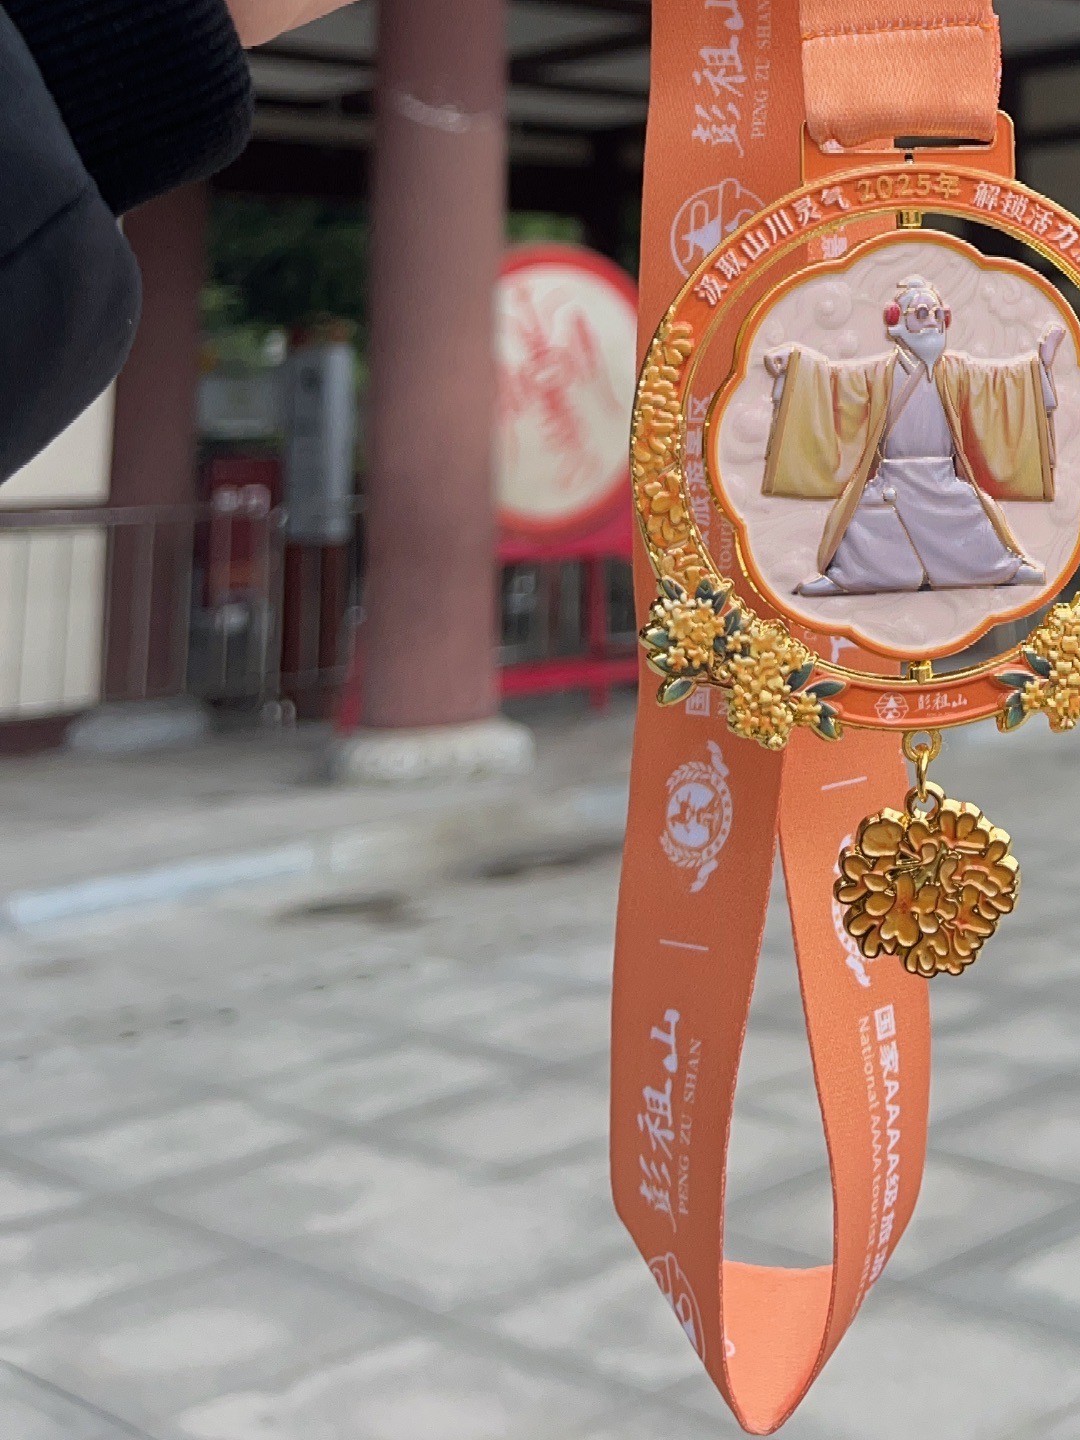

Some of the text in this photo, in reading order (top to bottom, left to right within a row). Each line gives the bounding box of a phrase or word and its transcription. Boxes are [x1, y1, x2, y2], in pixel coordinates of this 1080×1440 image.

[754, 55, 771, 82] ZU
[751, 88, 770, 140] PENG
[857, 173, 961, 203] 2025年
[918, 691, 968, 710] 彭祖山
[858, 1016, 880, 1111] National
[870, 1114, 883, 1173] AAAA
[637, 1009, 681, 1234] 彭祖山
[678, 1038, 702, 1216] PENG ZU SHAN
